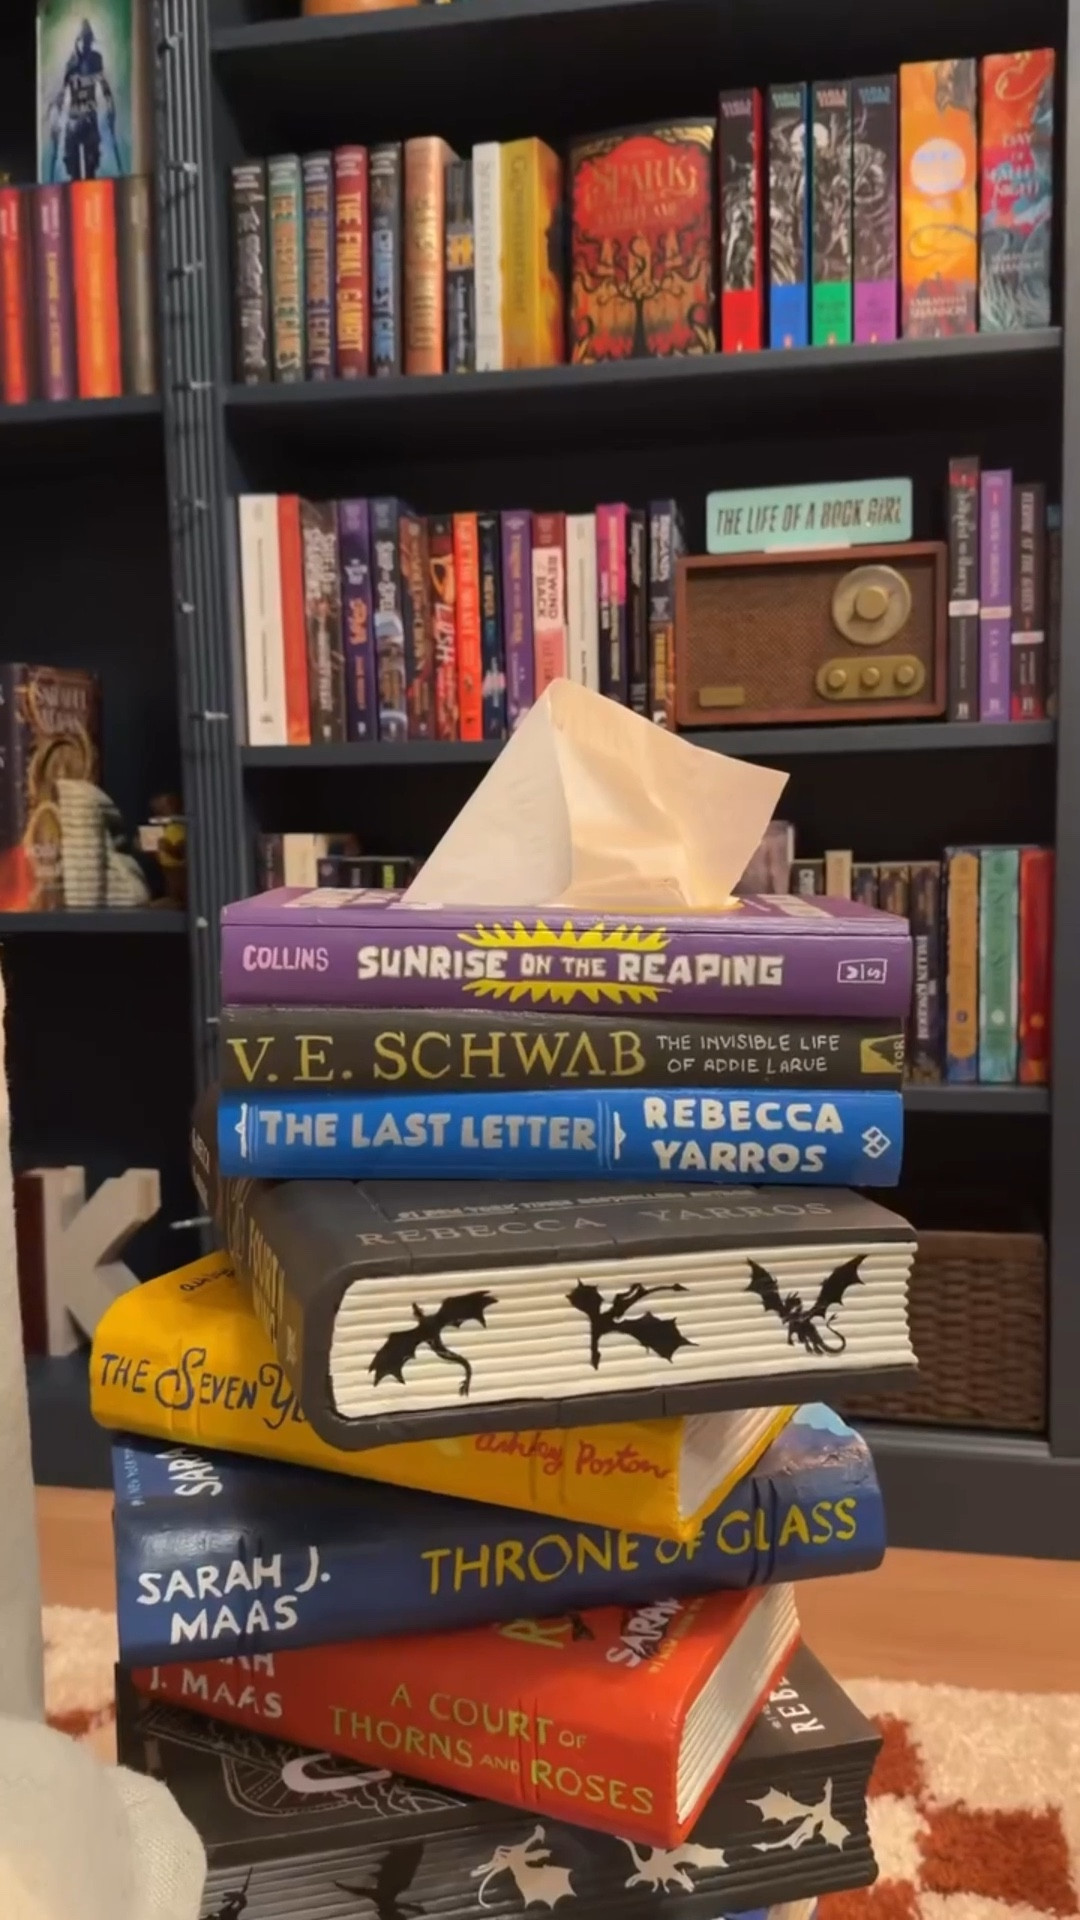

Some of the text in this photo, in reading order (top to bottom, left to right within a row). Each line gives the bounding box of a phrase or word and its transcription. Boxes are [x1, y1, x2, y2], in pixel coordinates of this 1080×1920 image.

[337, 193, 362, 226] THE
[337, 231, 362, 284] FINAL
[716, 495, 901, 536] THE LIFE OF A BOOK GIRL
[536, 576, 549, 619] BACK
[547, 555, 559, 620] REWIND
[435, 602, 456, 663] LUSH
[242, 945, 785, 986] COLLINS SUNRISE ON THE REAPING
[227, 1037, 278, 1082] V.
[656, 1034, 840, 1051] THE INVISIBLE LIFE
[667, 1057, 828, 1074] OF ADDIE LARUE
[258, 1110, 597, 1150] THE LAST LETTER
[643, 1096, 844, 1134] REBECCA
[652, 1139, 827, 1173] YARROS
[356, 1202, 834, 1248] REBECCA YARROS
[101, 1353, 151, 1393] THE
[420, 1498, 857, 1595] THRONE OF GLASS
[136, 1546, 331, 1605] SARAH J.
[169, 1595, 298, 1645] MAAS
[181, 1668, 283, 1719] MAAS
[390, 1683, 587, 1749] A COURT OF
[329, 1705, 655, 1816] THORNS AND ROSES
